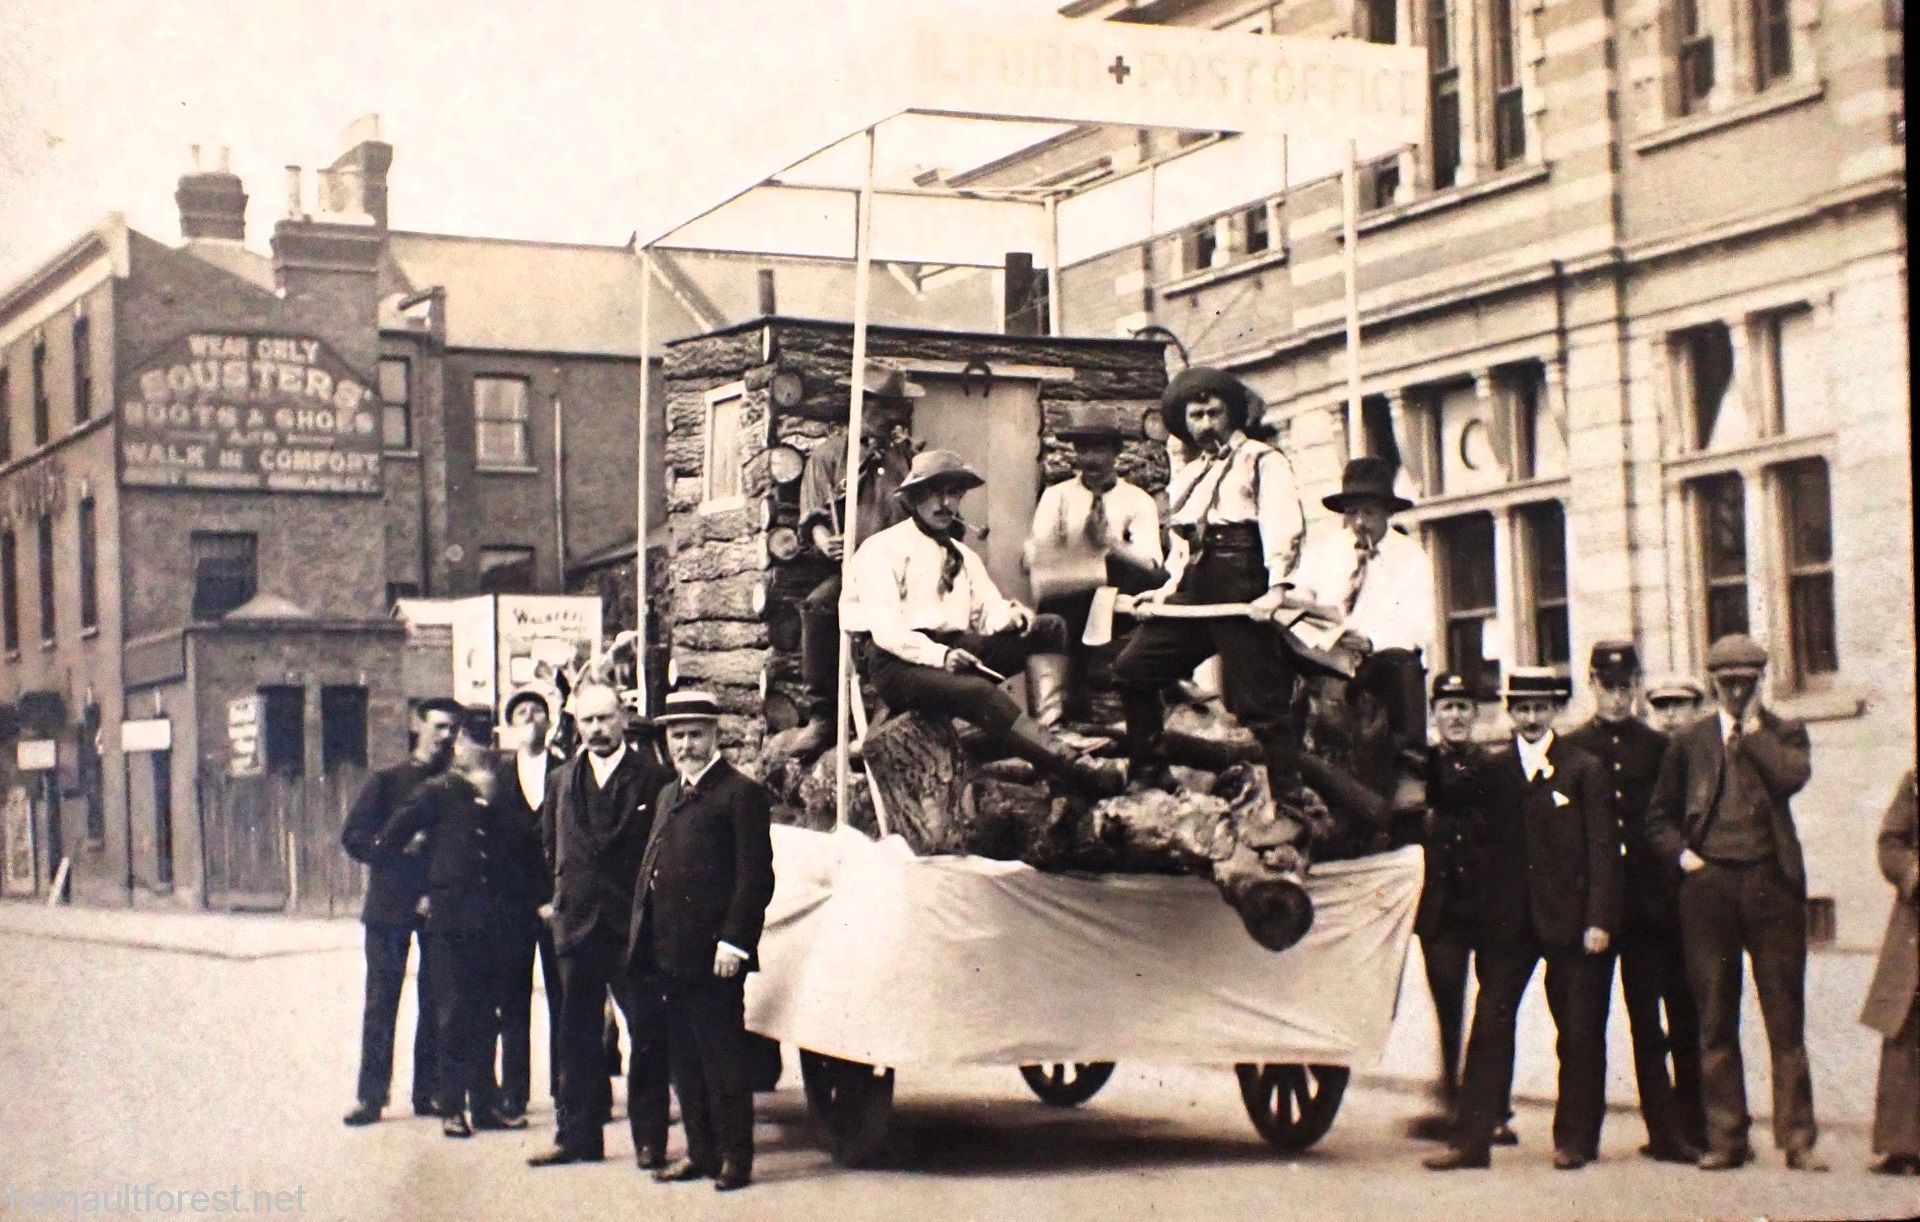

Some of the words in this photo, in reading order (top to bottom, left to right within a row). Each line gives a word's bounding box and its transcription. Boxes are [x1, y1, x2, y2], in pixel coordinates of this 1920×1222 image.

[1139, 52, 1260, 106] POST
[1271, 60, 1420, 118] OFFICE
[257, 337, 320, 364] ONLY
[124, 401, 239, 429] BOOTS
[275, 408, 375, 437] SHOES
[122, 442, 206, 468] WALK
